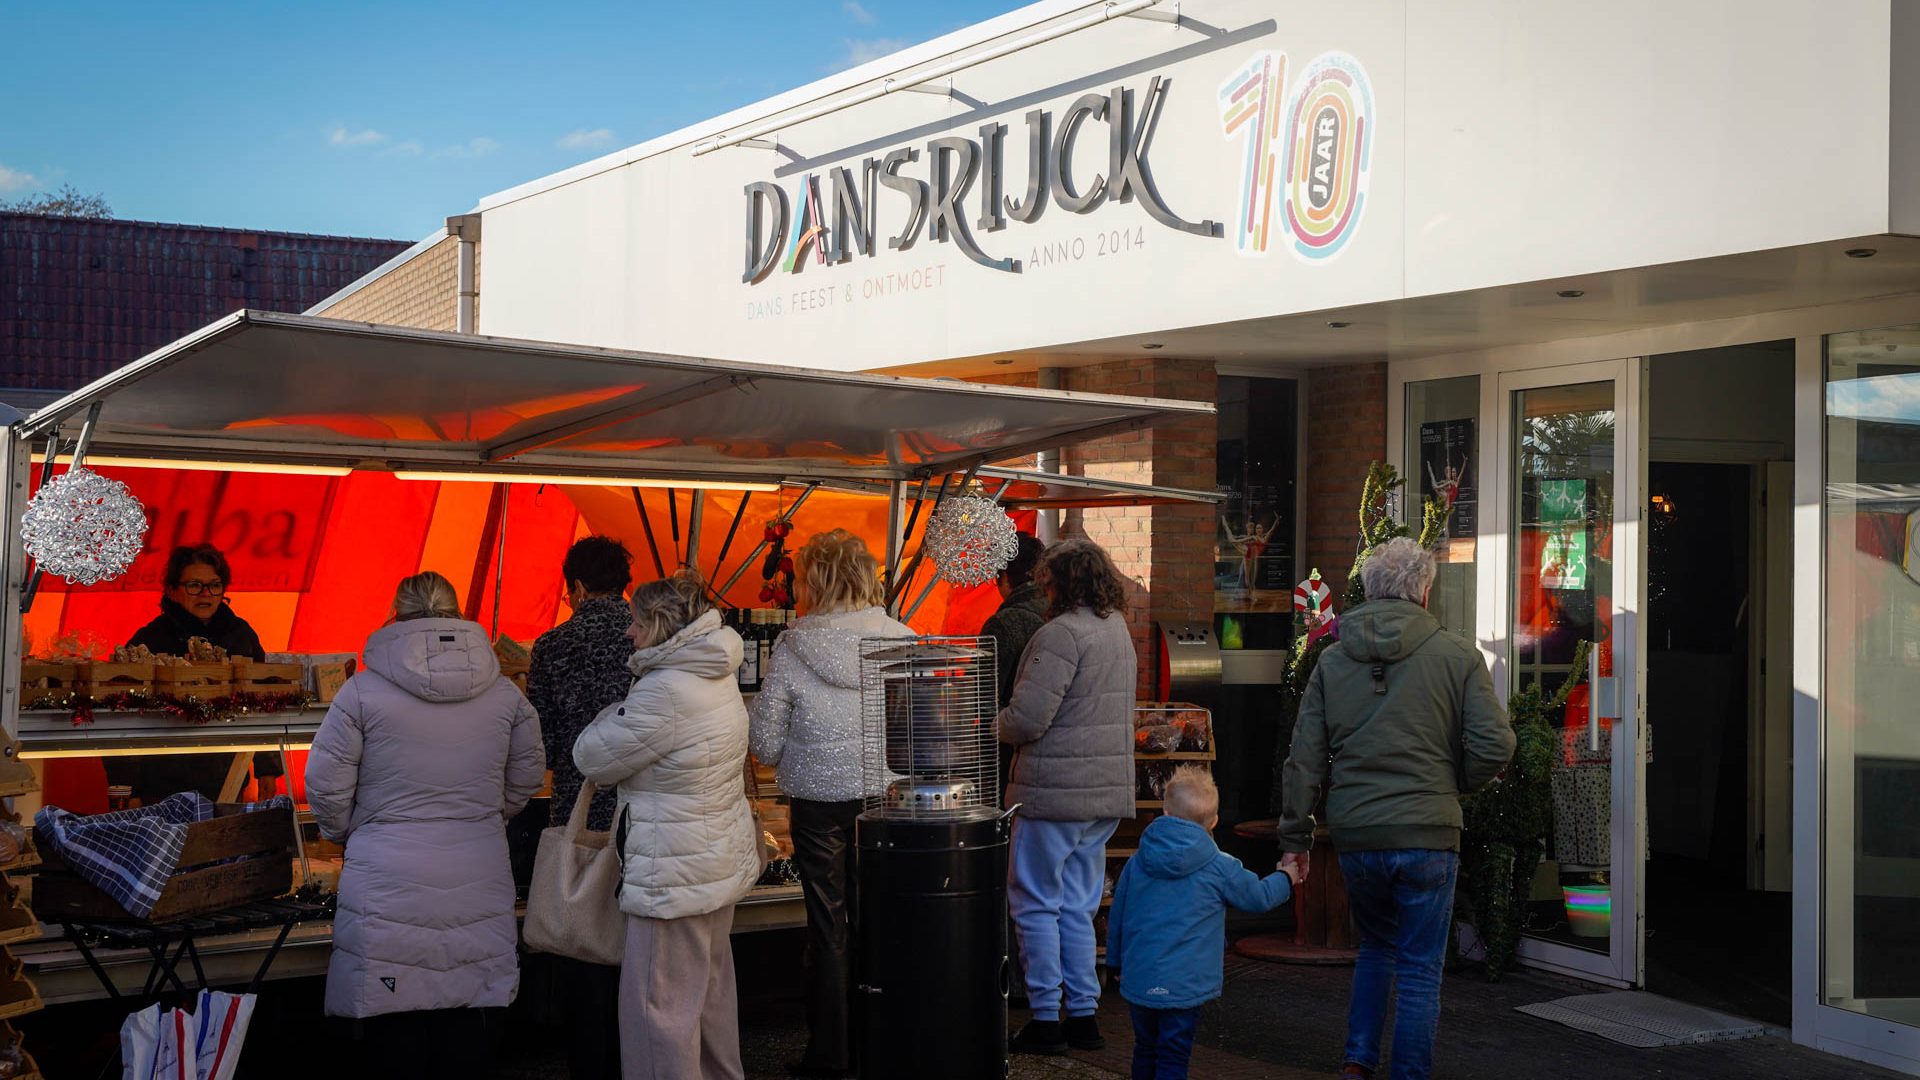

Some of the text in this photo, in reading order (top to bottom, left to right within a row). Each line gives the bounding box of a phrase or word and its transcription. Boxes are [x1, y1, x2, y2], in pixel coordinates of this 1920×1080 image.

[742, 75, 1218, 284] DANSRIJCK
[1218, 51, 1374, 264] 10
[1313, 117, 1335, 199] JAAR
[1029, 225, 1145, 269] ANNO 2014
[792, 286, 835, 313] FEEST
[844, 283, 853, 303] &
[862, 264, 946, 300] ONTMOET
